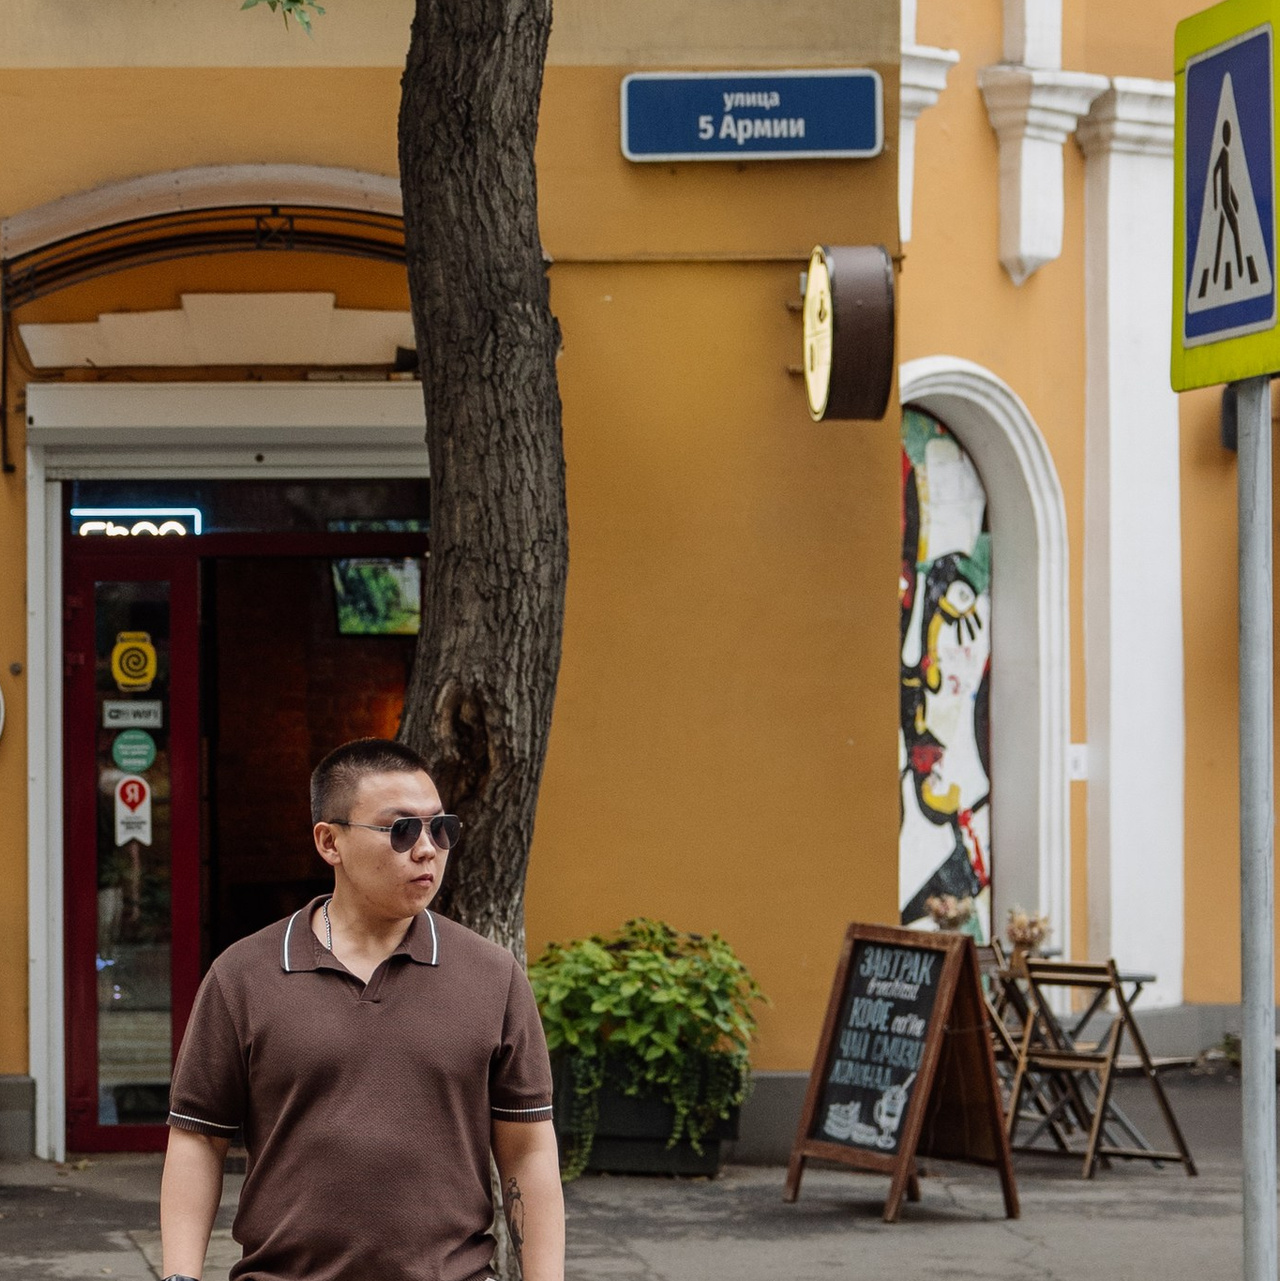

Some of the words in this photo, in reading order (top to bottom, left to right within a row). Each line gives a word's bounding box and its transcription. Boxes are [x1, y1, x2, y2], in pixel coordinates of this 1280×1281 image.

[723, 91, 781, 112] улица
[698, 116, 715, 140] 5
[719, 115, 806, 145] Армии
[125, 784, 140, 803] Я
[859, 946, 936, 986] ЗАВТРАК
[848, 996, 894, 1032] КОФЕ
